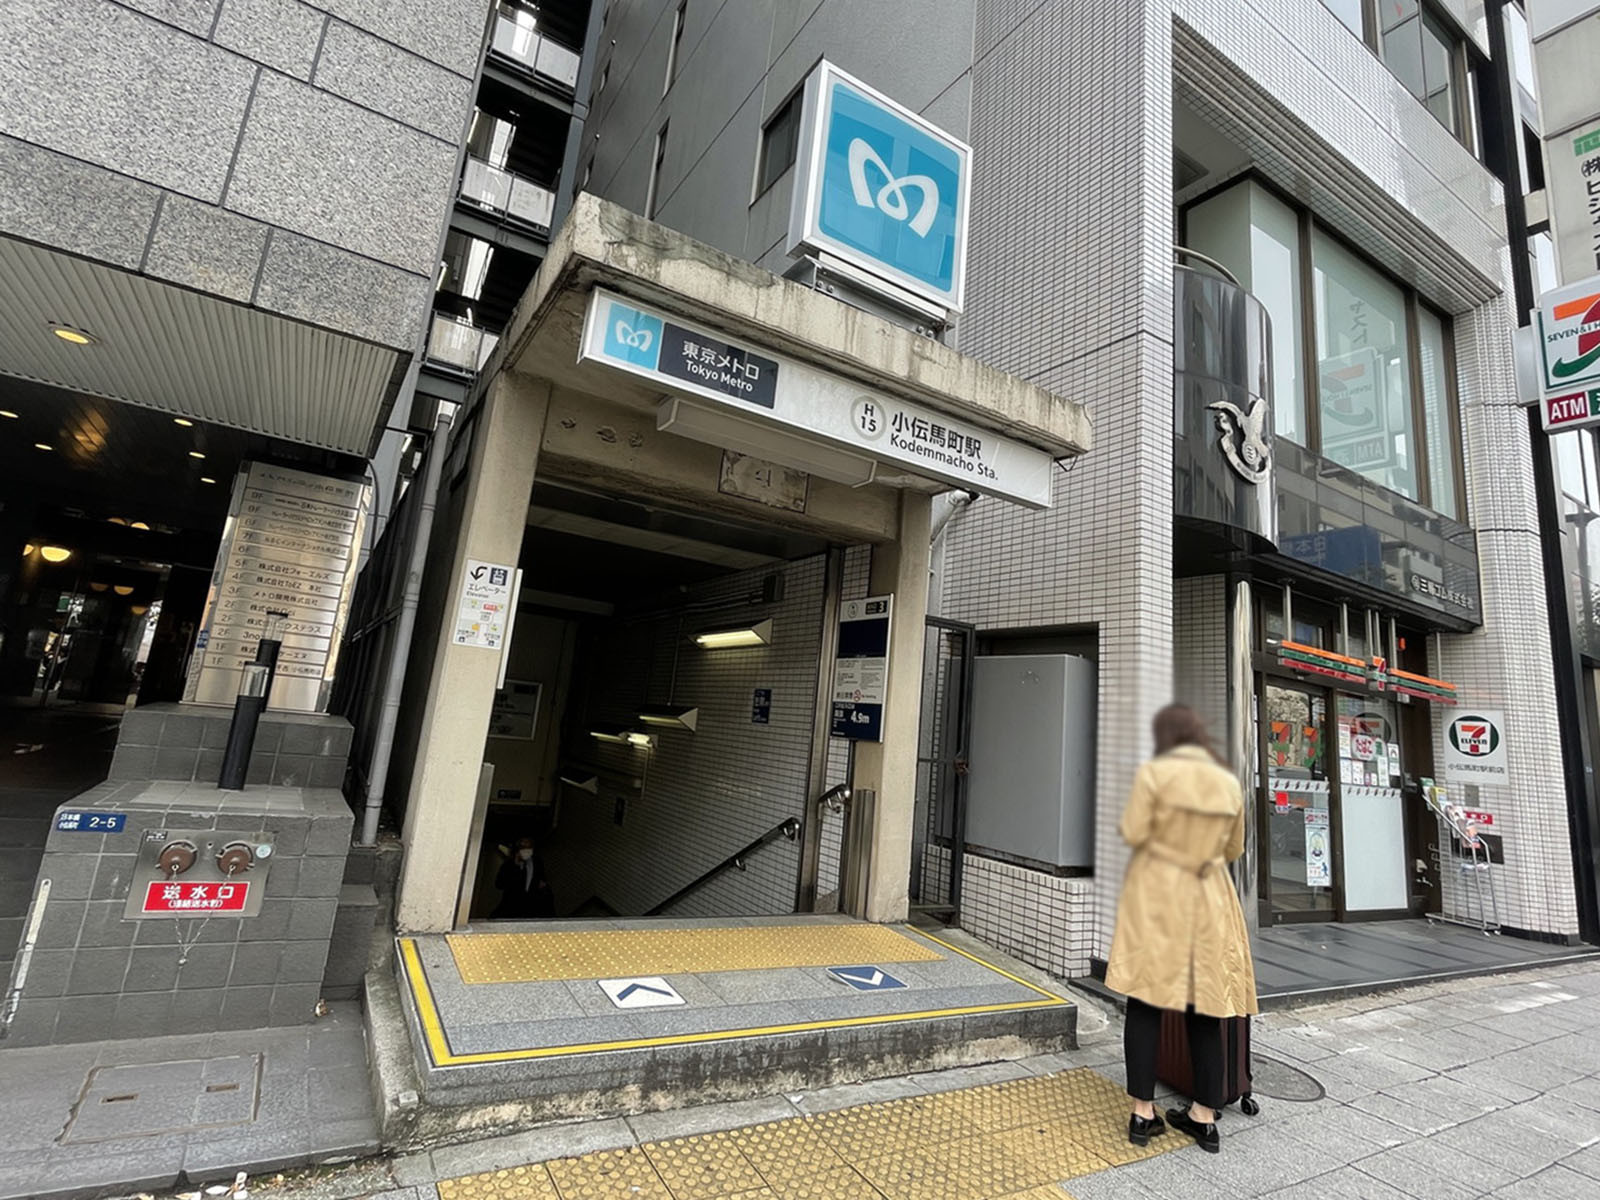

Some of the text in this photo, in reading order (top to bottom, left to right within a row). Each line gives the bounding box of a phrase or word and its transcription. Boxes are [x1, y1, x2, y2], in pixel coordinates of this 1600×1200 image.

[682, 340, 760, 380] 東京メトロ
[686, 359, 753, 392] Tokyo Metro
[864, 403, 874, 417] H
[1551, 396, 1586, 421] ATM
[861, 416, 877, 432] 15
[892, 411, 982, 460] 小伝馬町駅
[890, 432, 999, 480] Kodemmacho Sta.
[468, 583, 507, 595] エレベーター
[220, 614, 232, 622] 2F
[216, 628, 230, 636] 2F
[89, 816, 117, 829] 2-5
[162, 885, 235, 900] 送水口
